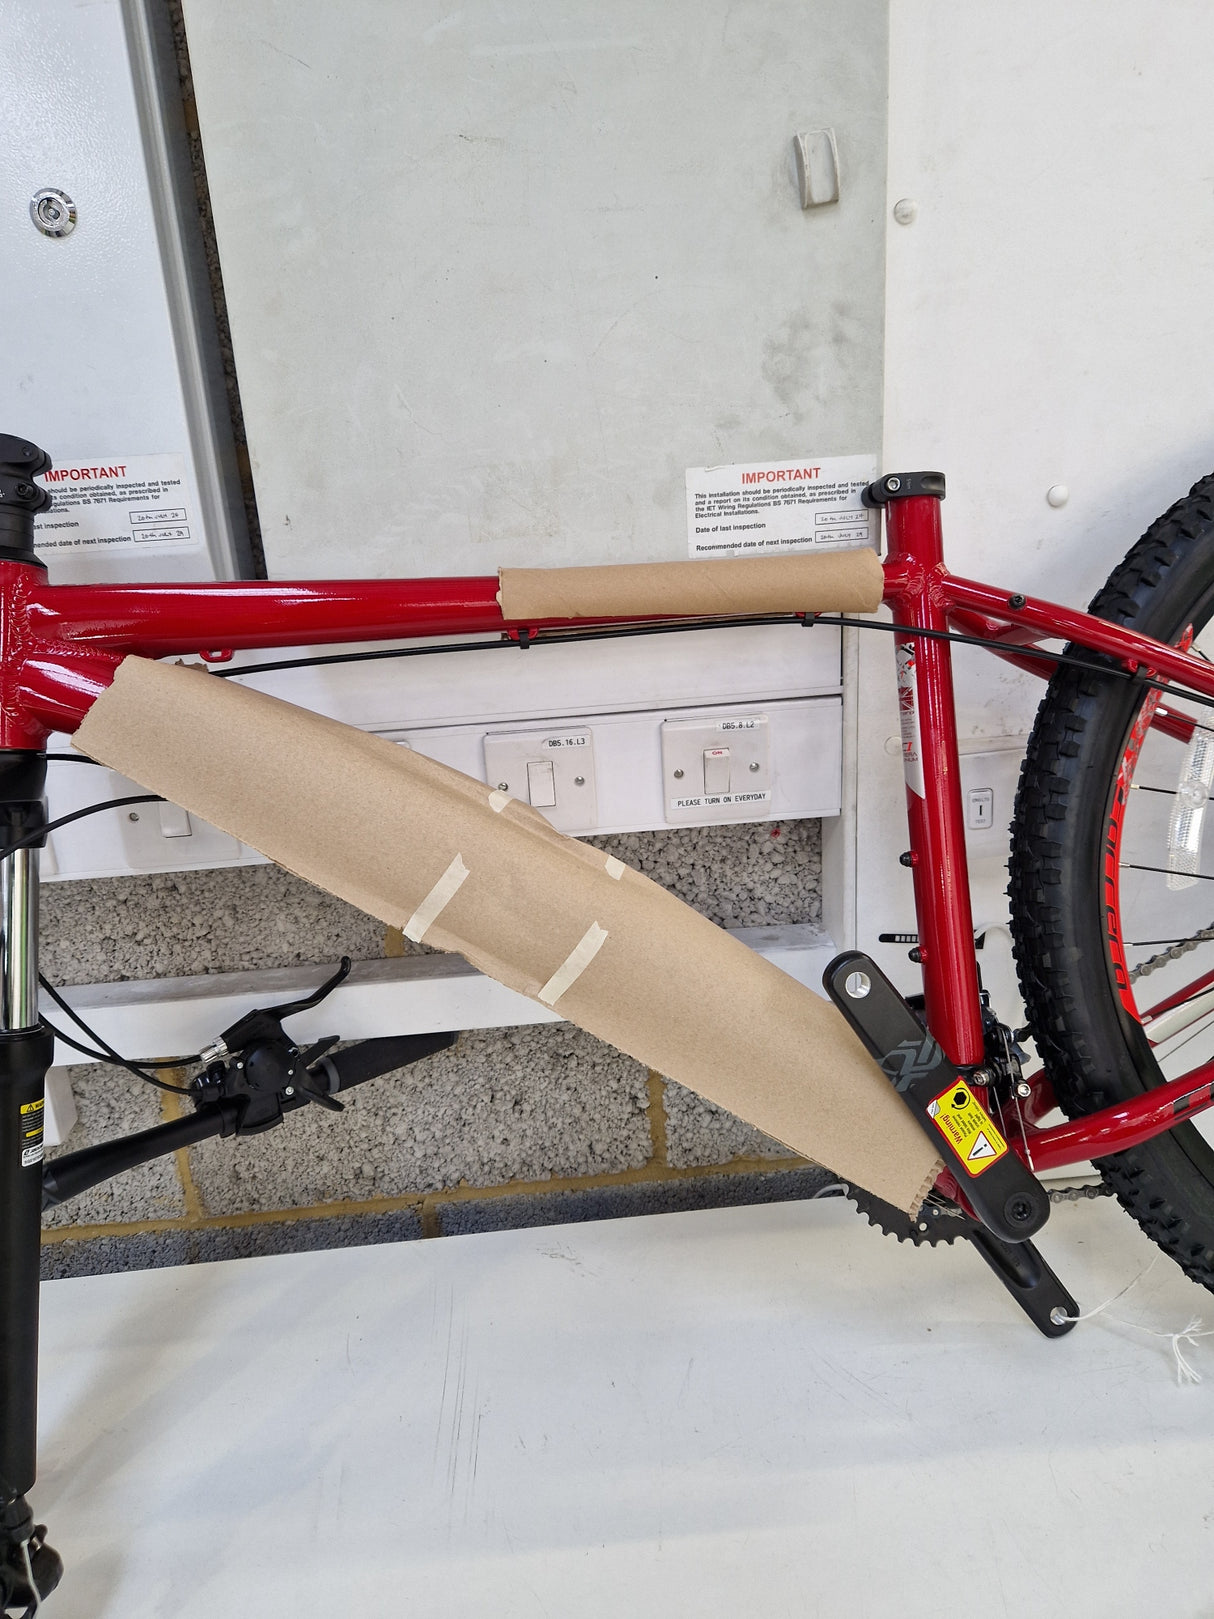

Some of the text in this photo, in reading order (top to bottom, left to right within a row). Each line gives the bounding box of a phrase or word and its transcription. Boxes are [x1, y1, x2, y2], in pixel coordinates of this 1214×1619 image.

[44, 466, 126, 482] IMPORTANT
[741, 467, 821, 484] IMPORTANT
[80, 484, 113, 492] periodically
[128, 488, 161, 496] prescribed
[772, 485, 806, 494] periodically
[807, 483, 836, 491] inspected
[109, 495, 149, 503] Requirements
[713, 498, 731, 506] report
[818, 488, 849, 497] prescribed
[737, 501, 771, 509] Regulations
[797, 496, 837, 504] Requirements
[695, 511, 722, 519] Electrical
[45, 521, 80, 530] inspection
[733, 522, 767, 531] inspection
[97, 535, 132, 545] inspection
[696, 542, 742, 551] Recommended
[780, 537, 813, 545] inspection
[722, 721, 755, 730] DB5.8.L2
[548, 737, 586, 747] DB5.16.L3
[677, 798, 701, 807] PLEASE
[734, 793, 766, 802] EVERYDAY
[939, 1113, 963, 1145] Warning!
